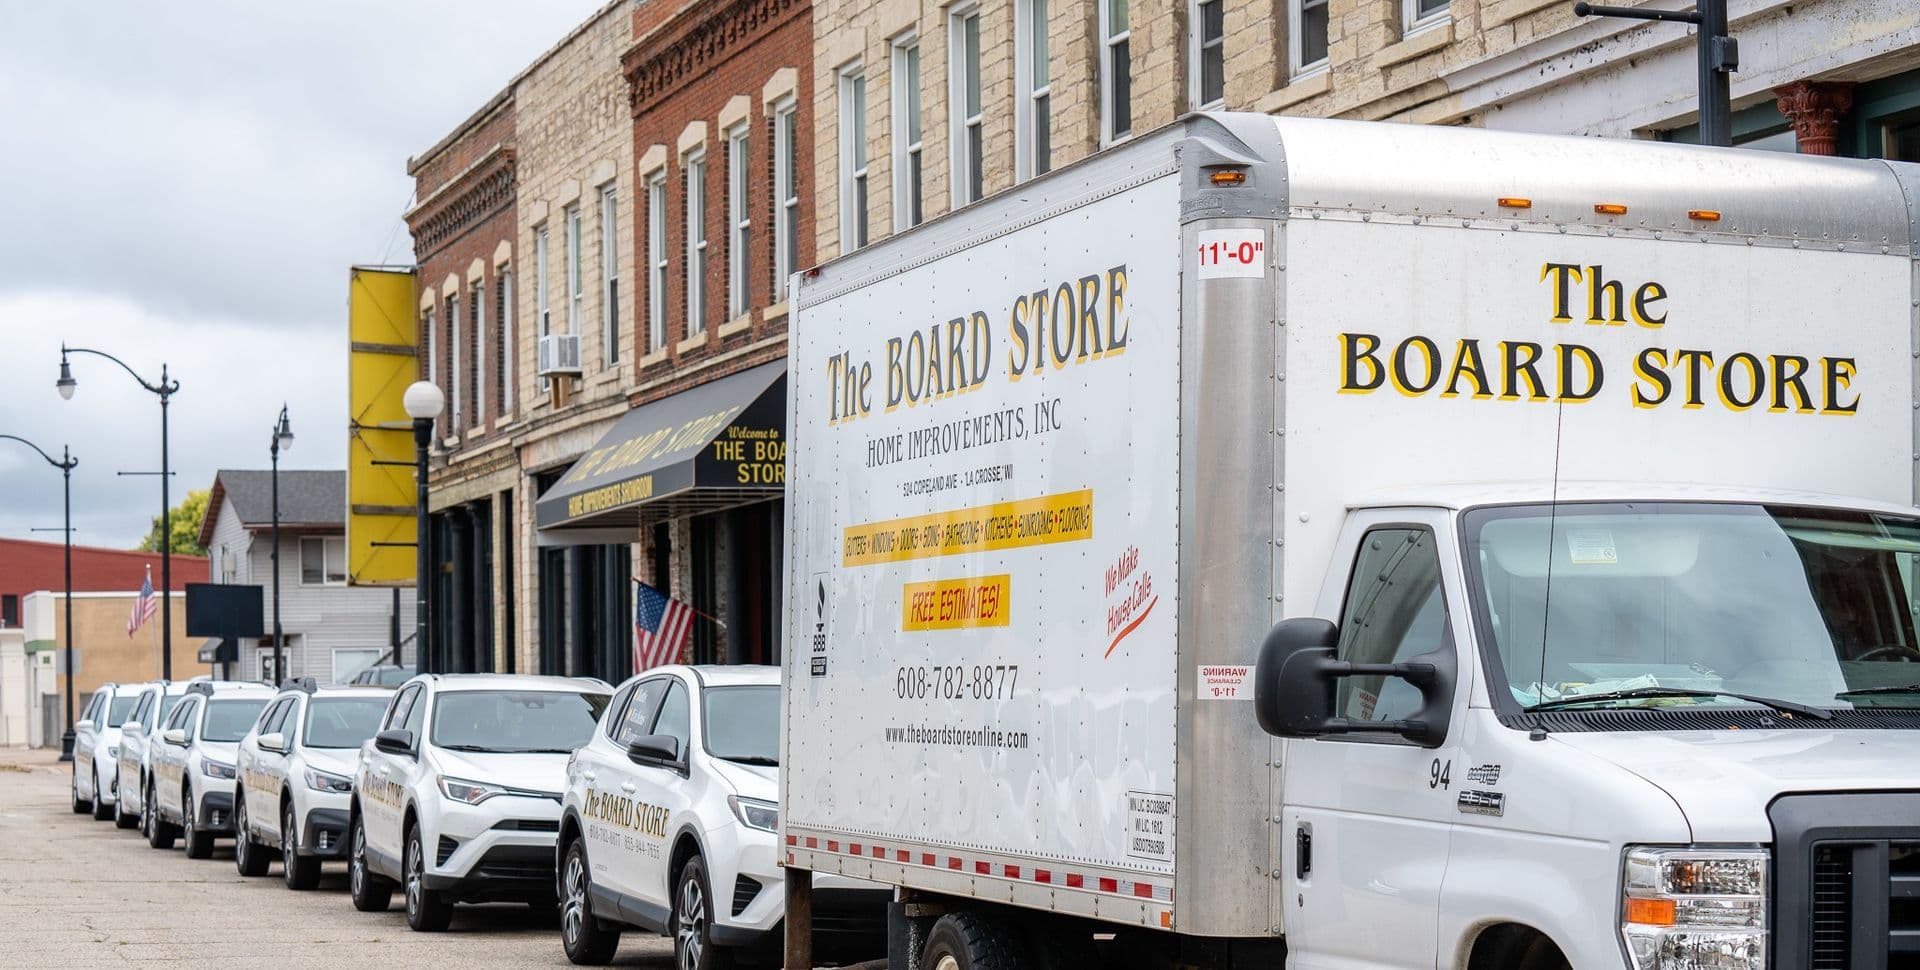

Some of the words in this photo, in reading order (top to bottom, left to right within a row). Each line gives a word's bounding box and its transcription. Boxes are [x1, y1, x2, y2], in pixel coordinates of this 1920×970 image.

[1199, 241, 1263, 266] 11'-0"
[1540, 262, 1669, 329] The
[826, 350, 872, 426] The
[884, 310, 992, 413] BOARD
[1009, 264, 1129, 382] STORE
[1337, 332, 1605, 404] BOARD
[1631, 346, 1861, 417] STORE
[713, 441, 745, 461] THE
[755, 441, 786, 461] BOA
[728, 426, 768, 439] Welcome
[769, 428, 779, 439] to
[868, 434, 903, 468] HOME
[908, 407, 1029, 460] IMPROVEMENTS,
[1034, 398, 1062, 435] INC
[738, 463, 785, 484] STOR
[913, 475, 944, 496] COPELAND
[945, 473, 958, 490] AVE
[900, 527, 919, 551] DOORS
[944, 520, 980, 548] BATHROOMS
[984, 514, 1014, 541] KITCHENS
[1017, 510, 1054, 538] SUNROOMS
[1058, 504, 1090, 534] FLOORING
[1105, 564, 1117, 598] We
[1118, 544, 1138, 585] Make
[911, 590, 936, 623] FREE
[940, 583, 1000, 621] ESTIMATES!
[1107, 596, 1132, 637] House
[1132, 571, 1152, 611] Calls
[813, 634, 826, 652] BBB
[897, 665, 1018, 700] 608-782-8877
[886, 723, 1028, 749] www.theboardstoreonline.com
[1430, 757, 1451, 791] 94
[584, 788, 600, 818] The
[600, 791, 633, 828] BOARD
[634, 801, 670, 838] STORE
